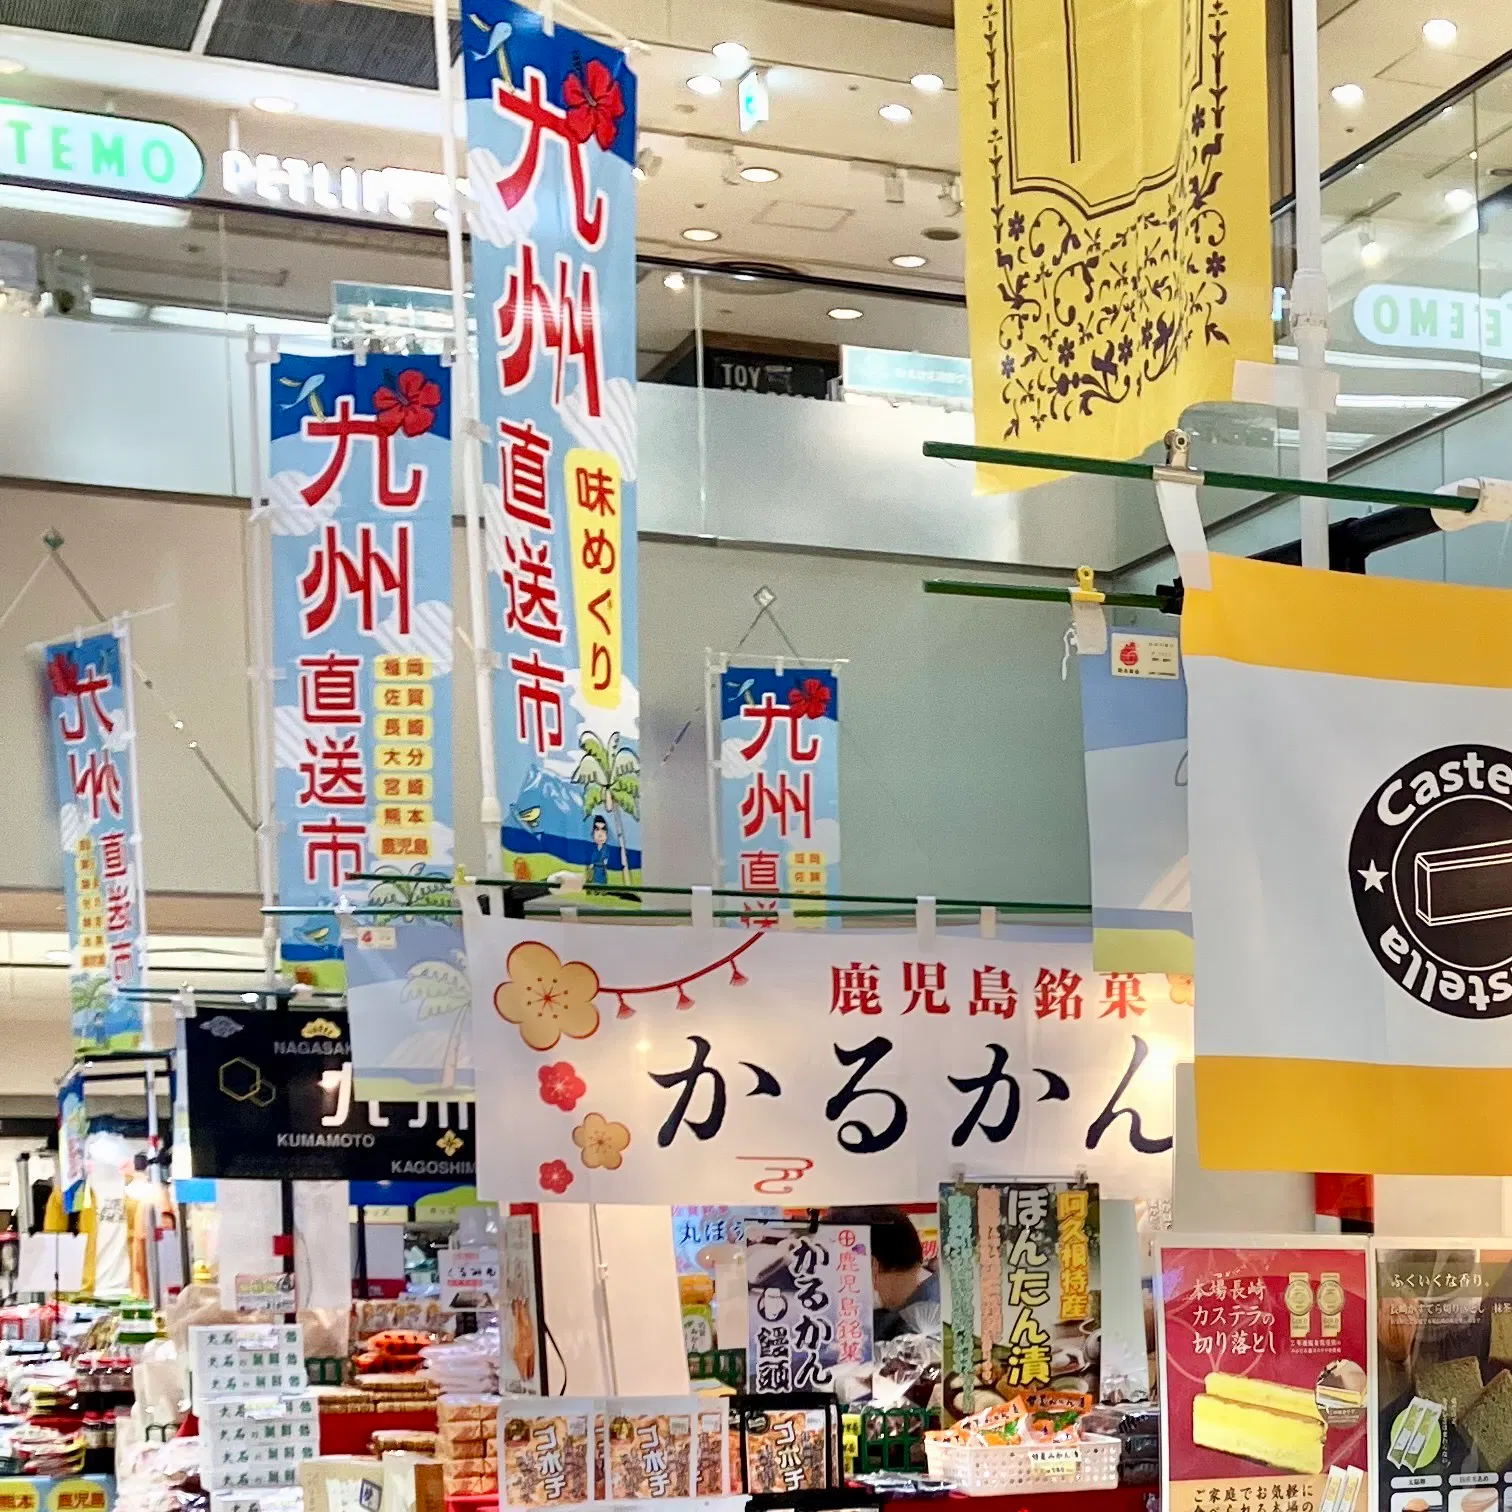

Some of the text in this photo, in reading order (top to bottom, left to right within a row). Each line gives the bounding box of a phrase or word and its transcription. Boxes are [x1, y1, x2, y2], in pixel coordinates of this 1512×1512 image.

[720, 363, 761, 388] TOY
[575, 467, 617, 692] 味めぐり
[384, 748, 424, 766] 大分
[829, 960, 1148, 1022] 鹿児島銘菓
[647, 1034, 1174, 1157] かるかん
[277, 1133, 375, 1149] KUMAMOTO
[1057, 1191, 1089, 1320] 阿久根特産
[1190, 1277, 1267, 1301] 本場長崎
[792, 1238, 833, 1388] かるかん
[1192, 1305, 1275, 1327] カステラの
[1192, 1330, 1276, 1355] 切り落とし
[1193, 1484, 1314, 1504] ご家庭でお気軽に
